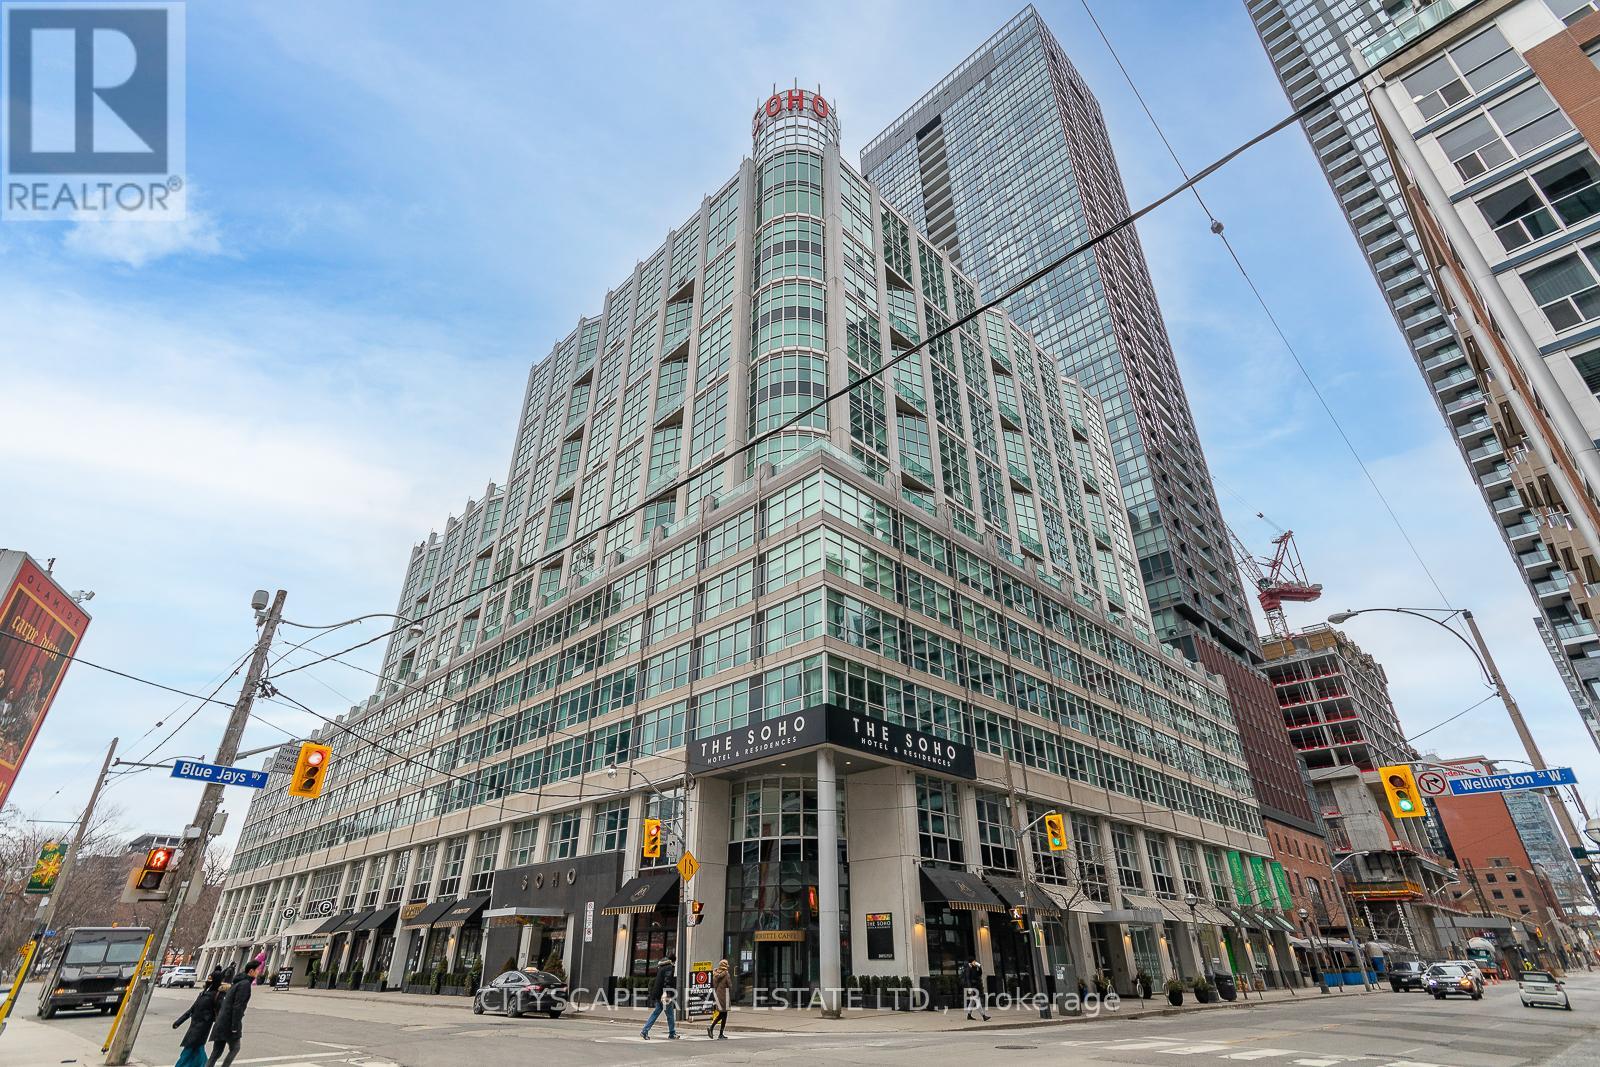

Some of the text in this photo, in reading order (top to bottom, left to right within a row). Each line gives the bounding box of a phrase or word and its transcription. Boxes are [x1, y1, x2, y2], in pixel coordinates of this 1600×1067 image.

[701, 716, 805, 757] THE SOHO
[707, 753, 731, 764] HOTEL
[744, 736, 797, 755] RESIDENCES
[852, 717, 956, 760] THE SOHO
[861, 738, 888, 751] HOTEL
[903, 749, 951, 767] RESIDENCES
[180, 763, 262, 783] Blue Jays Wy
[1460, 771, 1562, 790] Wellington St W
[521, 868, 577, 890] SOHO
